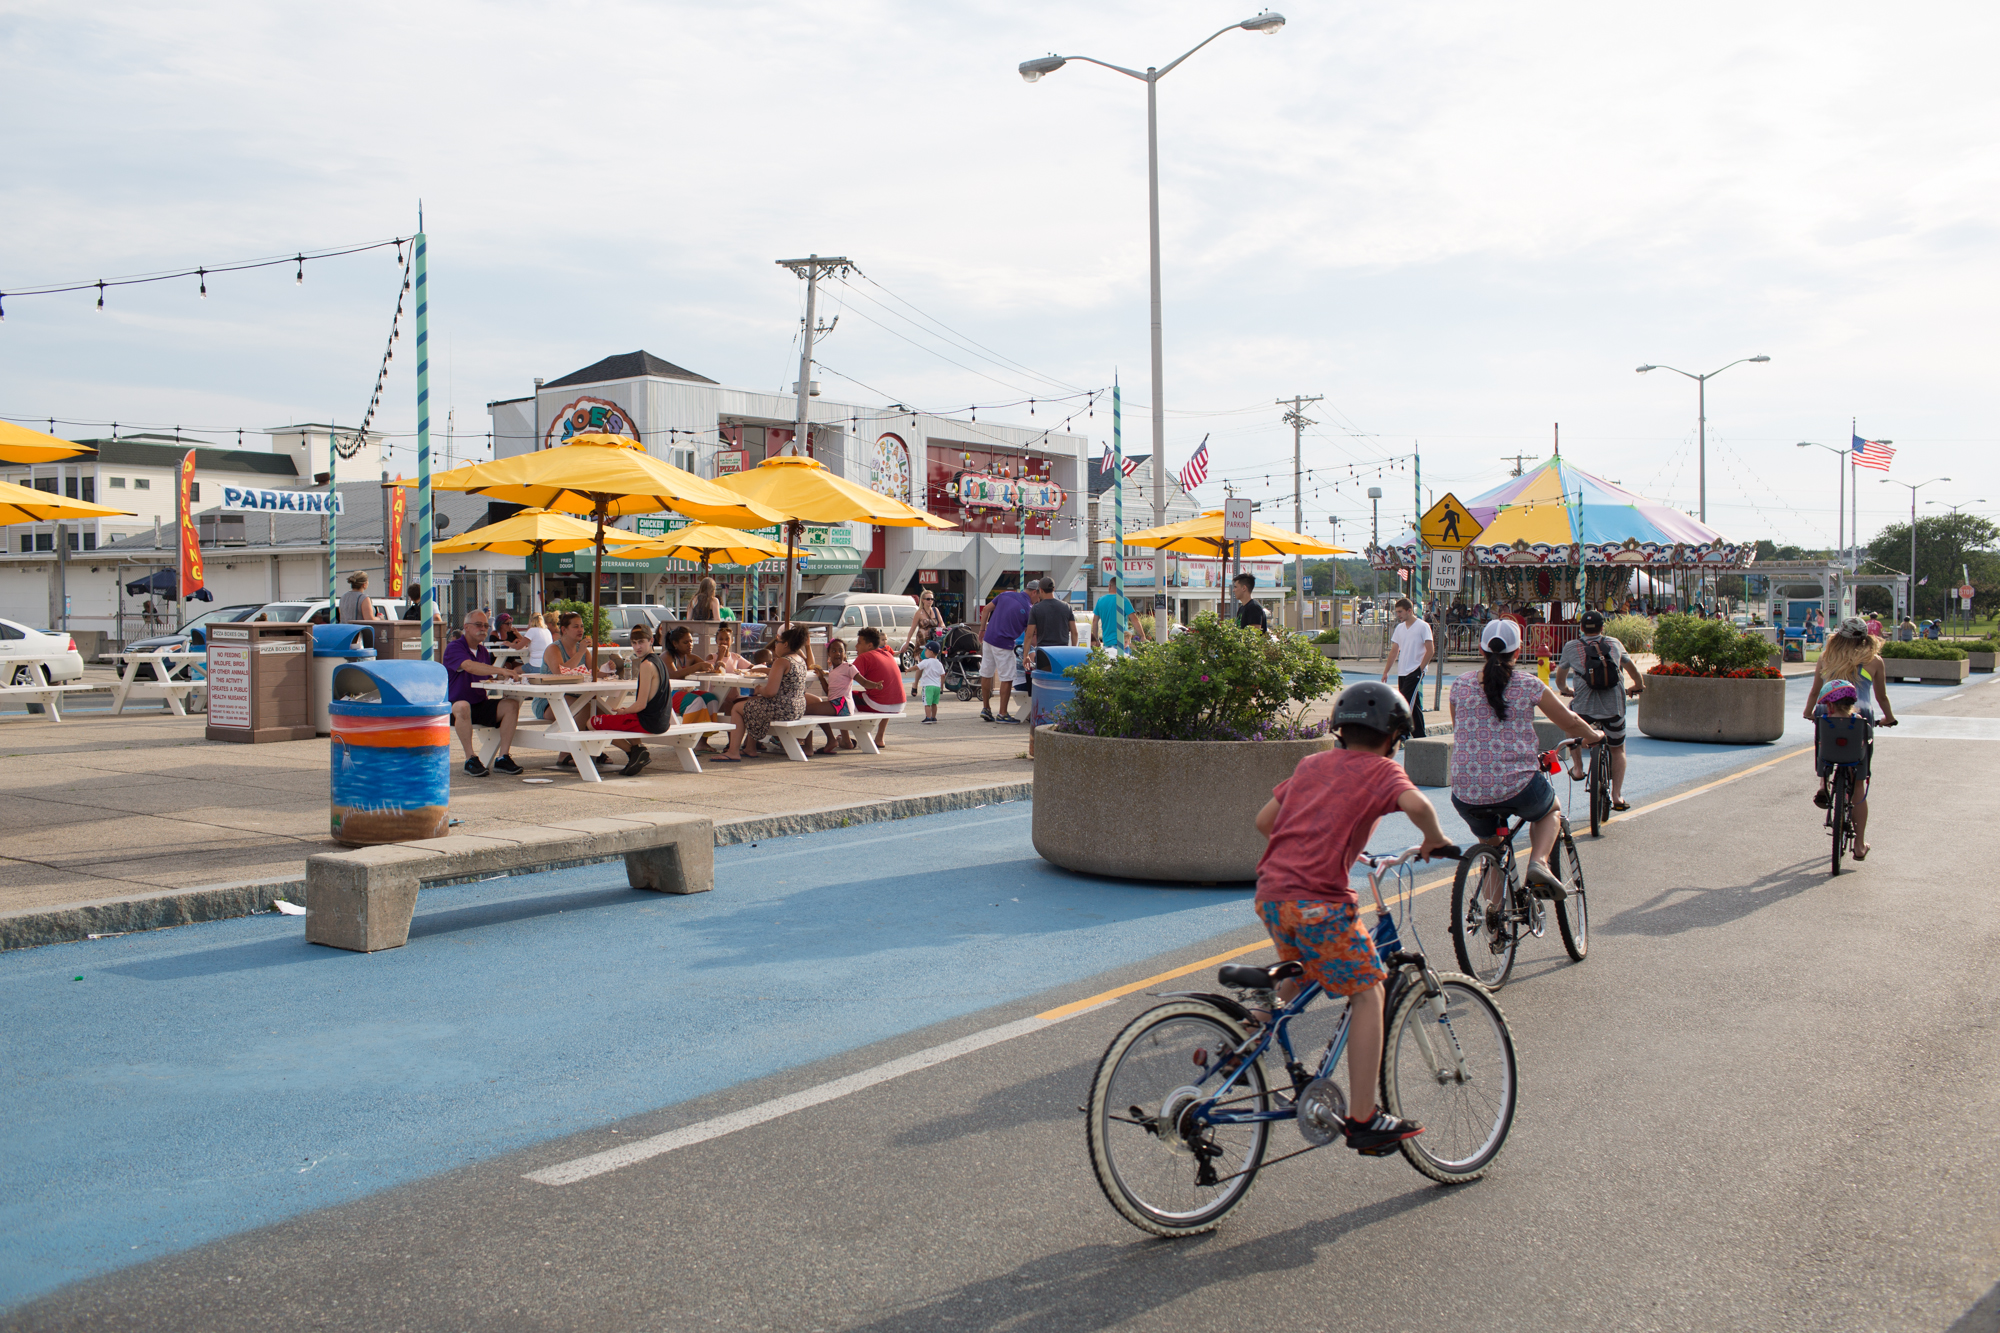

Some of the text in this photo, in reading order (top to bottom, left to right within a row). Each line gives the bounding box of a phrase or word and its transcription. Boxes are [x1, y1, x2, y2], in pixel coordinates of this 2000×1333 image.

[561, 405, 624, 443] JOE'S
[996, 484, 1058, 506] PLAYLAND
[225, 487, 341, 513] PARKING
[1232, 511, 1244, 519] NO
[639, 519, 665, 529] CHICKEN
[1226, 521, 1250, 529] PARKING
[639, 529, 665, 537] FINGERS
[807, 527, 829, 535] PEPPER
[831, 528, 852, 536] CHICKEN
[831, 537, 851, 545] FINGERS
[592, 560, 635, 568] MDITERRANEAN
[1441, 555, 1453, 564] NO
[665, 559, 786, 572] JILLYS PZZER
[1104, 560, 1154, 572] WILEY'S
[1437, 566, 1456, 575] LEFT
[920, 571, 937, 582] ATM
[1435, 577, 1456, 587] TURN
